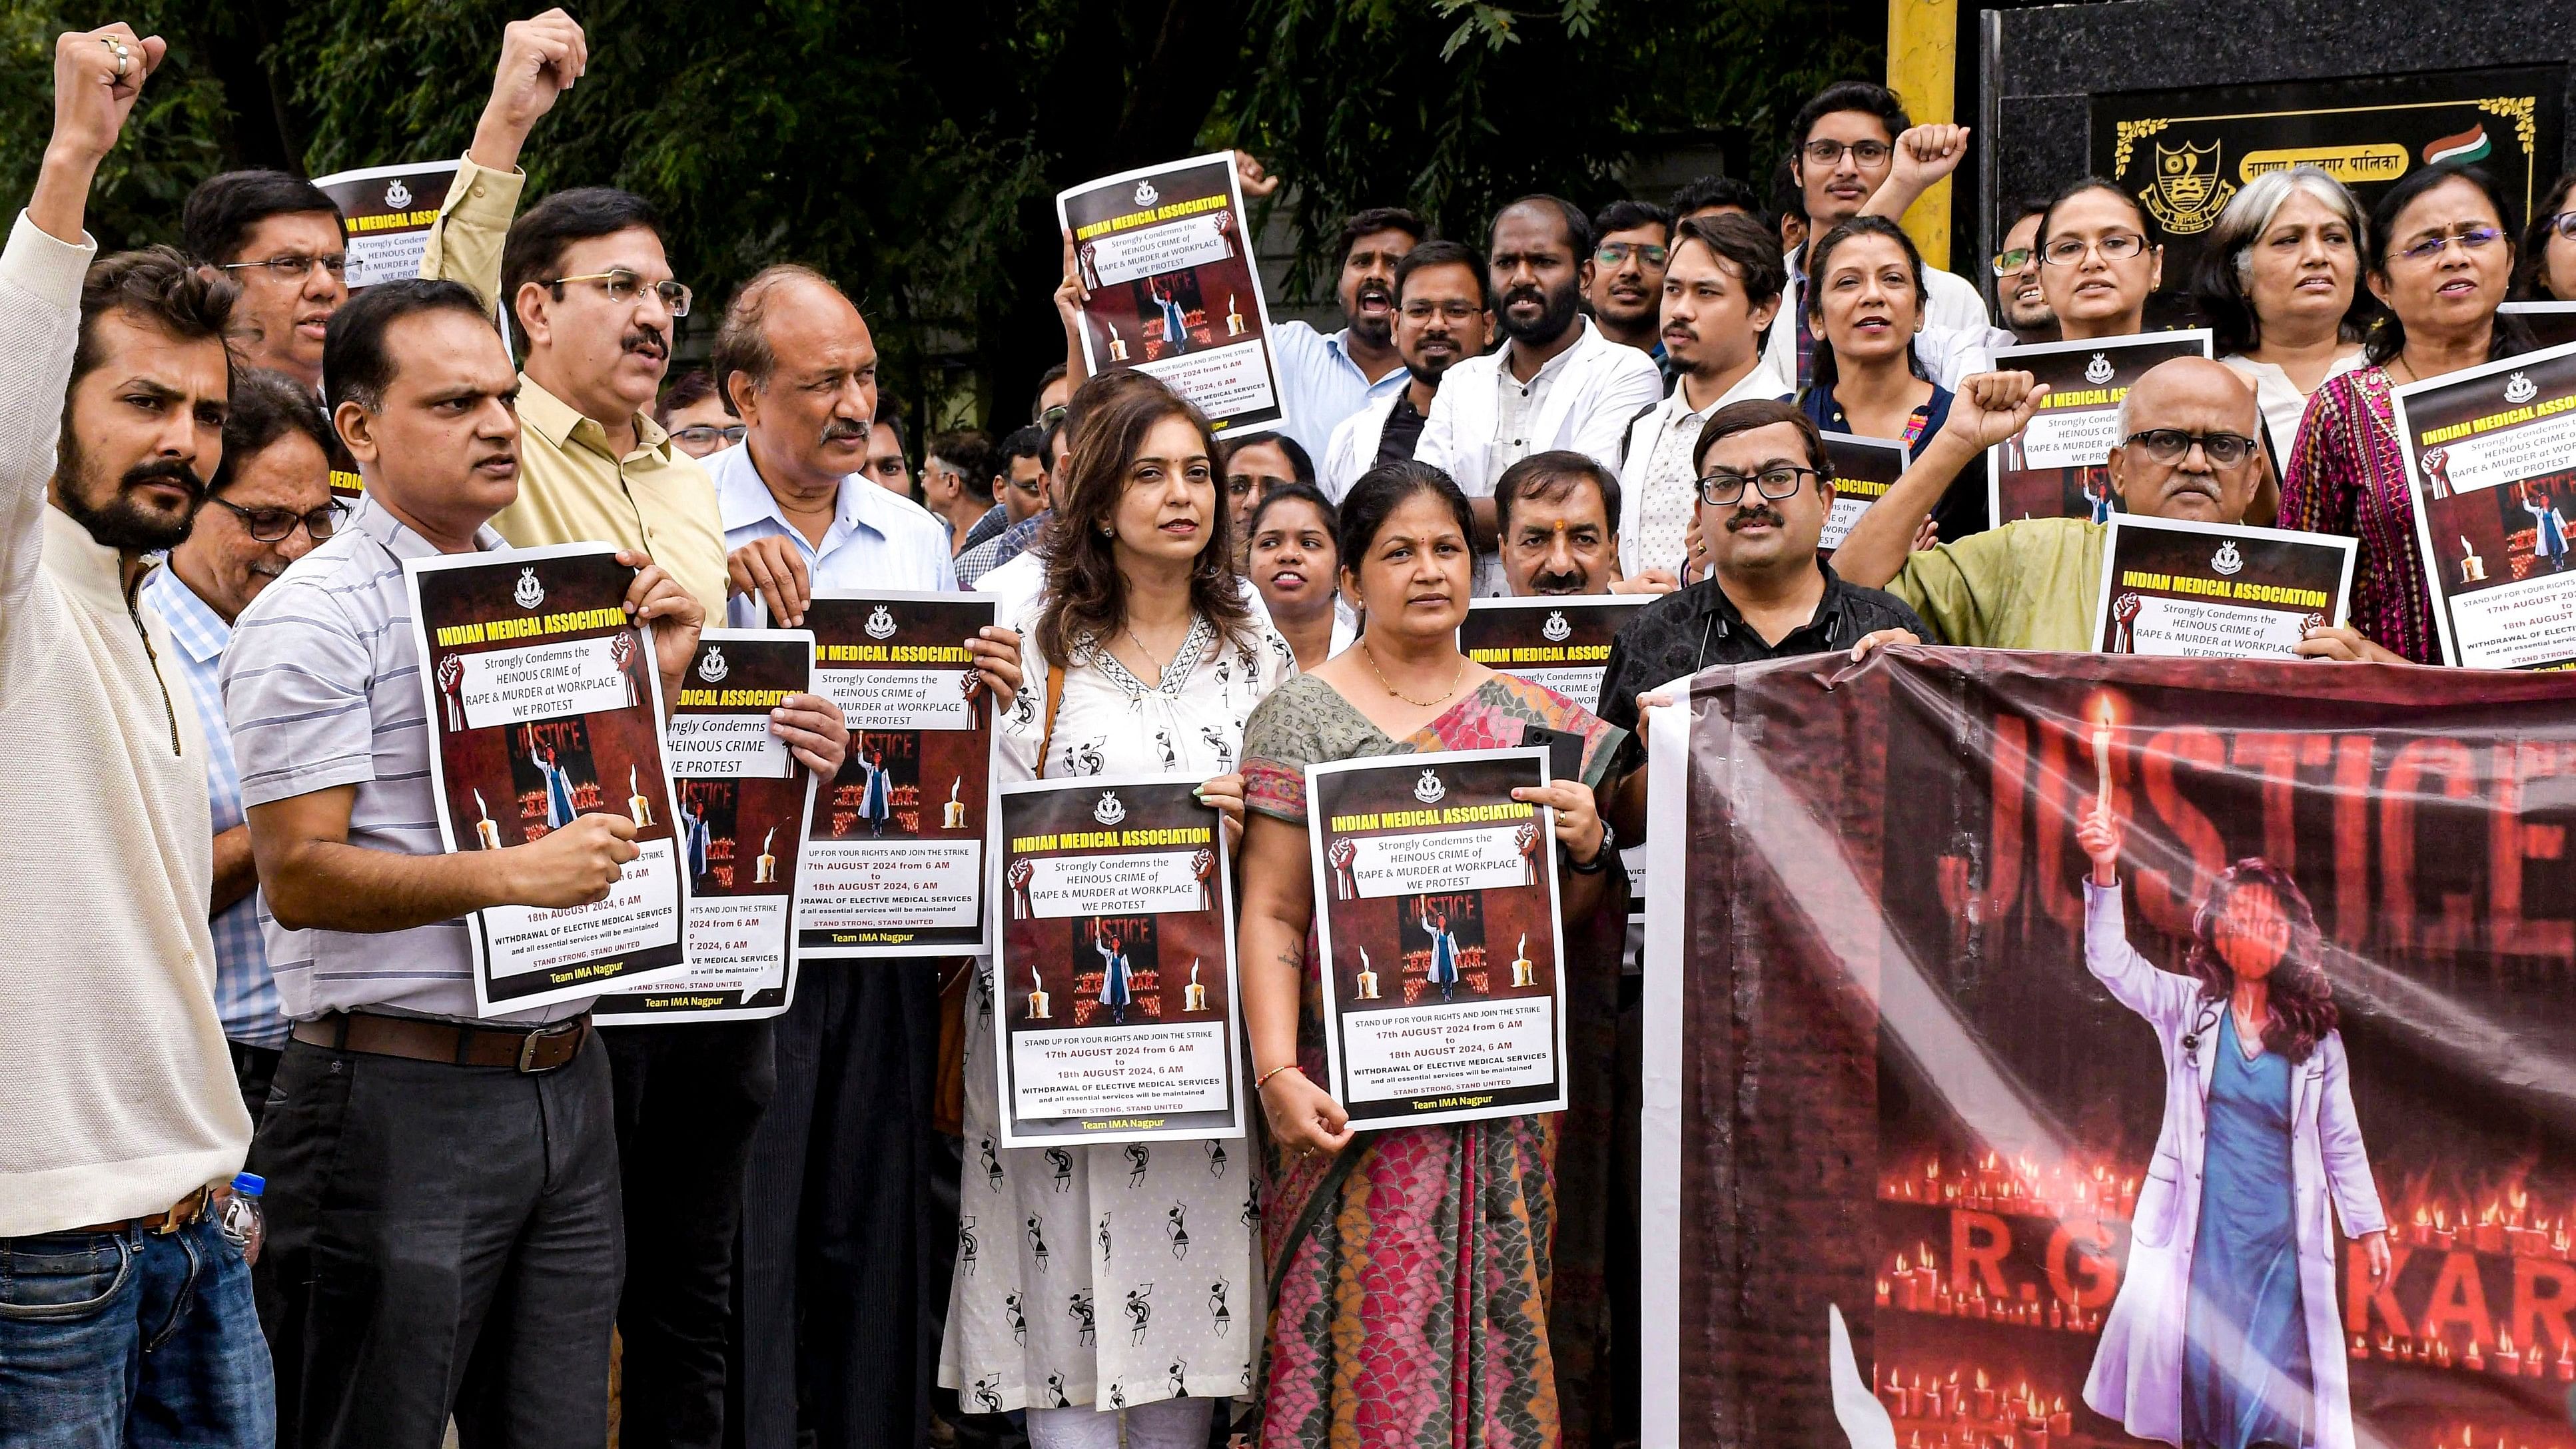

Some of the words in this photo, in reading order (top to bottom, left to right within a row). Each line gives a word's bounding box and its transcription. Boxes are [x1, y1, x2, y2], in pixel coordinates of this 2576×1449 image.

[2351, 151, 2400, 172] पालिका
[358, 213, 410, 231] MEDICAL
[1077, 221, 1111, 241] INDIAN
[1112, 211, 1157, 231] MEDICAL
[1158, 195, 1227, 220] ASSOCIATION
[368, 248, 405, 259] HEINOUS
[1122, 242, 1156, 256] HEINOUS
[1157, 237, 1180, 248] CRIME
[1182, 234, 1190, 243] of
[1136, 266, 1149, 274] WE
[1150, 257, 1184, 271] PROTEST
[2053, 389, 2109, 408] MEDICAL
[2048, 416, 2086, 428] Strongly
[2422, 422, 2472, 446] INDIAN
[2472, 406, 2536, 433] MEDICAL
[2058, 428, 2100, 438] HEINOUS
[2471, 435, 2513, 452] Strongly
[2516, 422, 2569, 439] Condemns
[2485, 441, 2531, 459] HEINOUS
[2533, 432, 2566, 446] CRIME
[2503, 468, 2521, 478] WE
[2523, 456, 2570, 474] PROTEST
[1843, 504, 1857, 512] the
[1838, 515, 1847, 524] of
[2122, 571, 2171, 590] INDIAN
[2172, 576, 2232, 598] MEDICAL
[2233, 582, 2327, 608] ASSOCIATION
[2463, 597, 2490, 608] STAND
[2522, 585, 2545, 594] YOUR
[2546, 579, 2575, 590] RIGHTS
[2487, 605, 2509, 614] 17th
[2513, 595, 2556, 609] AUGUST
[2163, 604, 2205, 618] Strongly
[2207, 609, 2258, 622] Condemns
[2260, 615, 2277, 625] the
[437, 624, 485, 646] INDIAN
[486, 617, 543, 641] MEDICAL
[544, 607, 627, 634] ASSOCIATION
[2172, 619, 2218, 632] HEINOUS
[2220, 624, 2252, 636] CRIME
[2254, 628, 2265, 638] of
[485, 654, 524, 670] Strongly
[526, 650, 572, 664] Condemns
[575, 646, 590, 658] the
[829, 645, 889, 662] MEDICAL
[891, 646, 973, 662] ASSOCIATIO
[1470, 648, 1511, 663] INDIAN
[1512, 647, 1565, 662] MEDICAL
[496, 670, 538, 685] HEINOUS
[540, 666, 570, 679] CRIME
[572, 664, 581, 677] of
[1547, 672, 1592, 681] Condemns
[466, 693, 490, 706] RAPE
[492, 692, 500, 702] &
[502, 686, 543, 702] MURDER
[545, 686, 555, 696] at
[556, 676, 617, 694] WORKPLACE
[833, 688, 879, 698] HEINOUS
[881, 689, 913, 698] CRIME
[915, 689, 927, 700] of
[1559, 684, 1588, 693] CRIME
[1591, 684, 1599, 694] of
[702, 720, 766, 731] Condemns
[866, 716, 912, 725] PROTEST
[667, 740, 722, 752] HEINOUS
[725, 740, 765, 752] CRIME
[686, 761, 743, 772] PROTEST
[1332, 813, 1380, 832] INDIAN
[1382, 809, 1442, 828] MEDICAL
[1443, 803, 1534, 824] ASSOCIATION
[1013, 835, 1058, 853] INDIAN
[1060, 831, 1120, 849] MEDICAL
[1122, 827, 1210, 846] ASSOCIATION
[1378, 839, 1420, 851] Strongly
[1422, 836, 1474, 847] Condemns
[1476, 833, 1492, 843] the
[1938, 713, 2575, 954] JUSTICE
[1391, 851, 1436, 863] HEINOUS
[1438, 849, 1469, 859] CRIME
[1472, 847, 1482, 859] of
[1055, 861, 1097, 873] Strongly
[1099, 859, 1150, 869] Condemns
[1153, 858, 1168, 867] the
[1067, 874, 1112, 884] HEINOUS
[1114, 873, 1146, 882] CRIME
[1148, 871, 1158, 883] of
[1033, 890, 1059, 900] RAPE
[1061, 890, 1069, 899] &
[1072, 888, 1115, 898] MURDER
[1118, 887, 1128, 896] at
[1131, 884, 1192, 895] WORKPLACE
[1082, 902, 1098, 911] WE
[1101, 900, 1146, 910] PROTEST
[550, 972, 574, 983] Team
[574, 967, 592, 979] IMA
[593, 961, 624, 976] Nagpur
[645, 999, 669, 1007] Team
[671, 997, 689, 1006] IMA
[691, 997, 723, 1008] Nagpur
[1070, 1049, 1113, 1057] AUGUST
[1116, 1047, 1140, 1055] 2024
[1083, 1069, 1125, 1077] AUGUST
[1022, 1085, 1080, 1095] WITHDRAWAL
[1412, 1101, 1438, 1110] Team
[1439, 1097, 1458, 1107] IMA
[1460, 1095, 1493, 1107] Nagpur
[1081, 1121, 1109, 1130] Team
[1108, 1119, 1130, 1129] IMA
[1130, 1119, 1164, 1129] Nagpur
